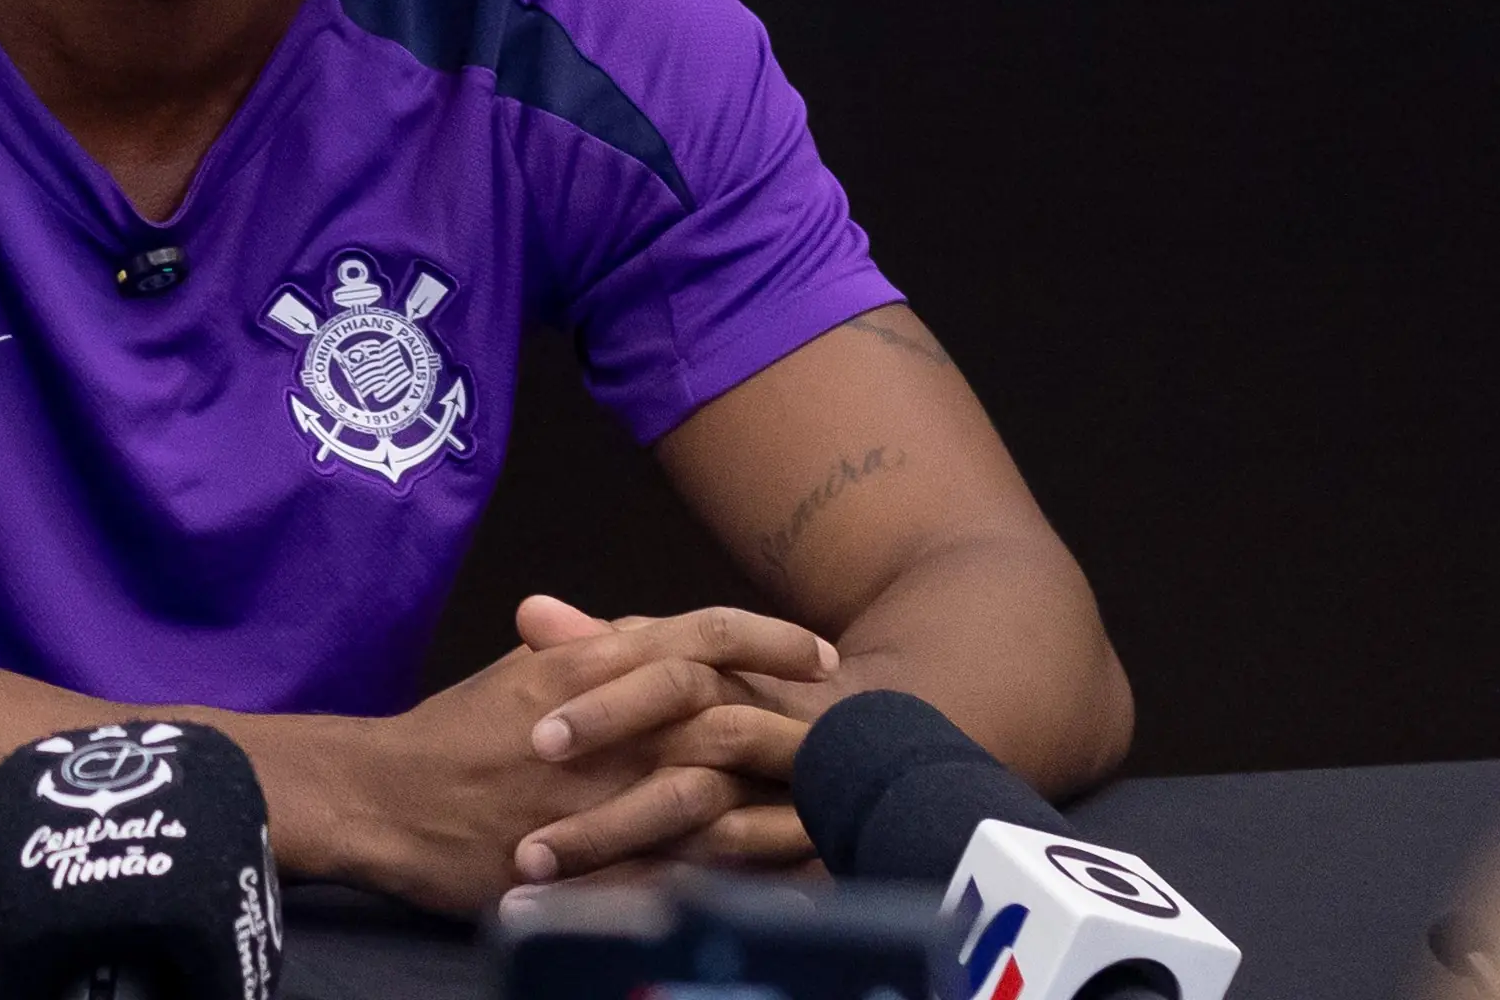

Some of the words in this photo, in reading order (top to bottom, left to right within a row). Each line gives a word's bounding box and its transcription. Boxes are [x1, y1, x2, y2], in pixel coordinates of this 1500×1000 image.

[314, 317, 395, 385] CORINTHIANS
[396, 326, 428, 401] PAULISTA
[364, 410, 400, 425] 1910
[20, 809, 165, 868] Central
[46, 845, 173, 890] Timão
